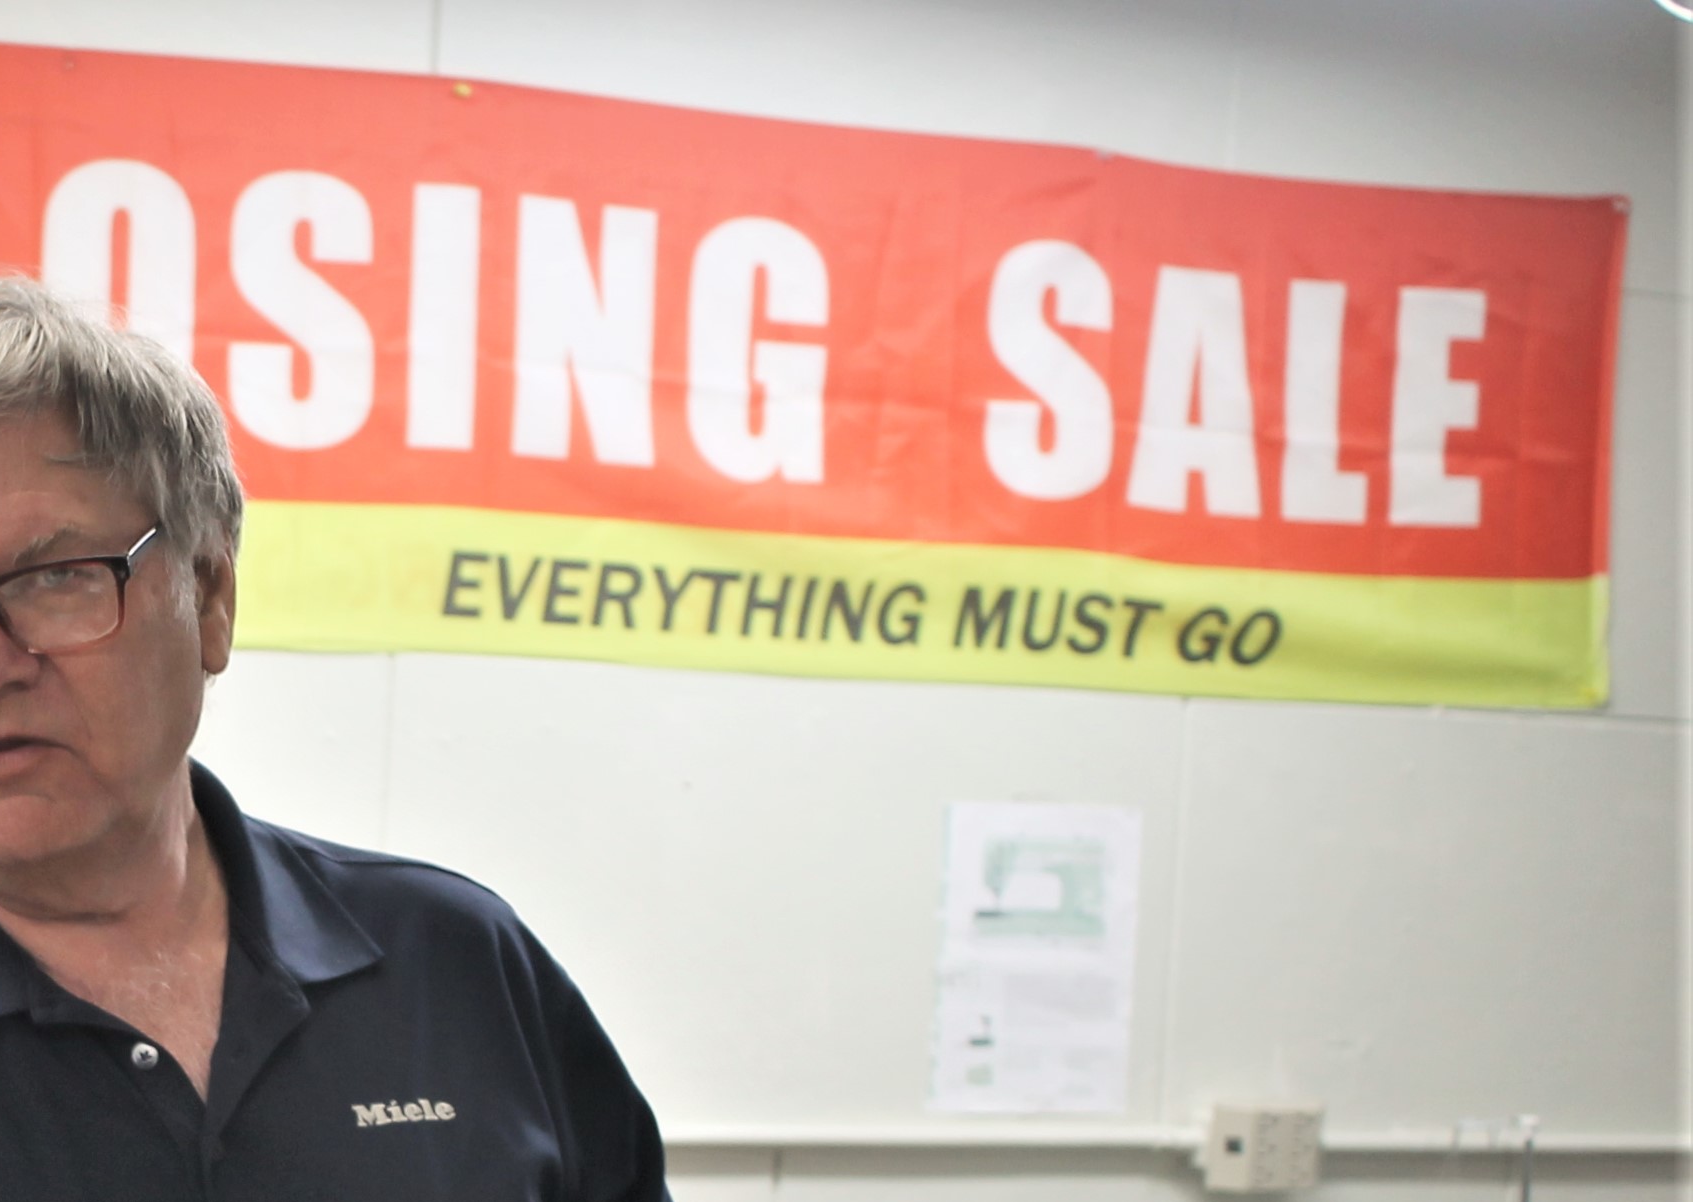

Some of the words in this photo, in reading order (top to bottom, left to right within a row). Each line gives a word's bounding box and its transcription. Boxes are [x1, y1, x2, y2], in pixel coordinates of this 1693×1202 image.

[983, 239, 1487, 529] SALE
[440, 550, 927, 647] EVERYTHING
[952, 584, 1163, 662] MUST
[1176, 607, 1284, 668] GO
[351, 1098, 456, 1127] Miele
